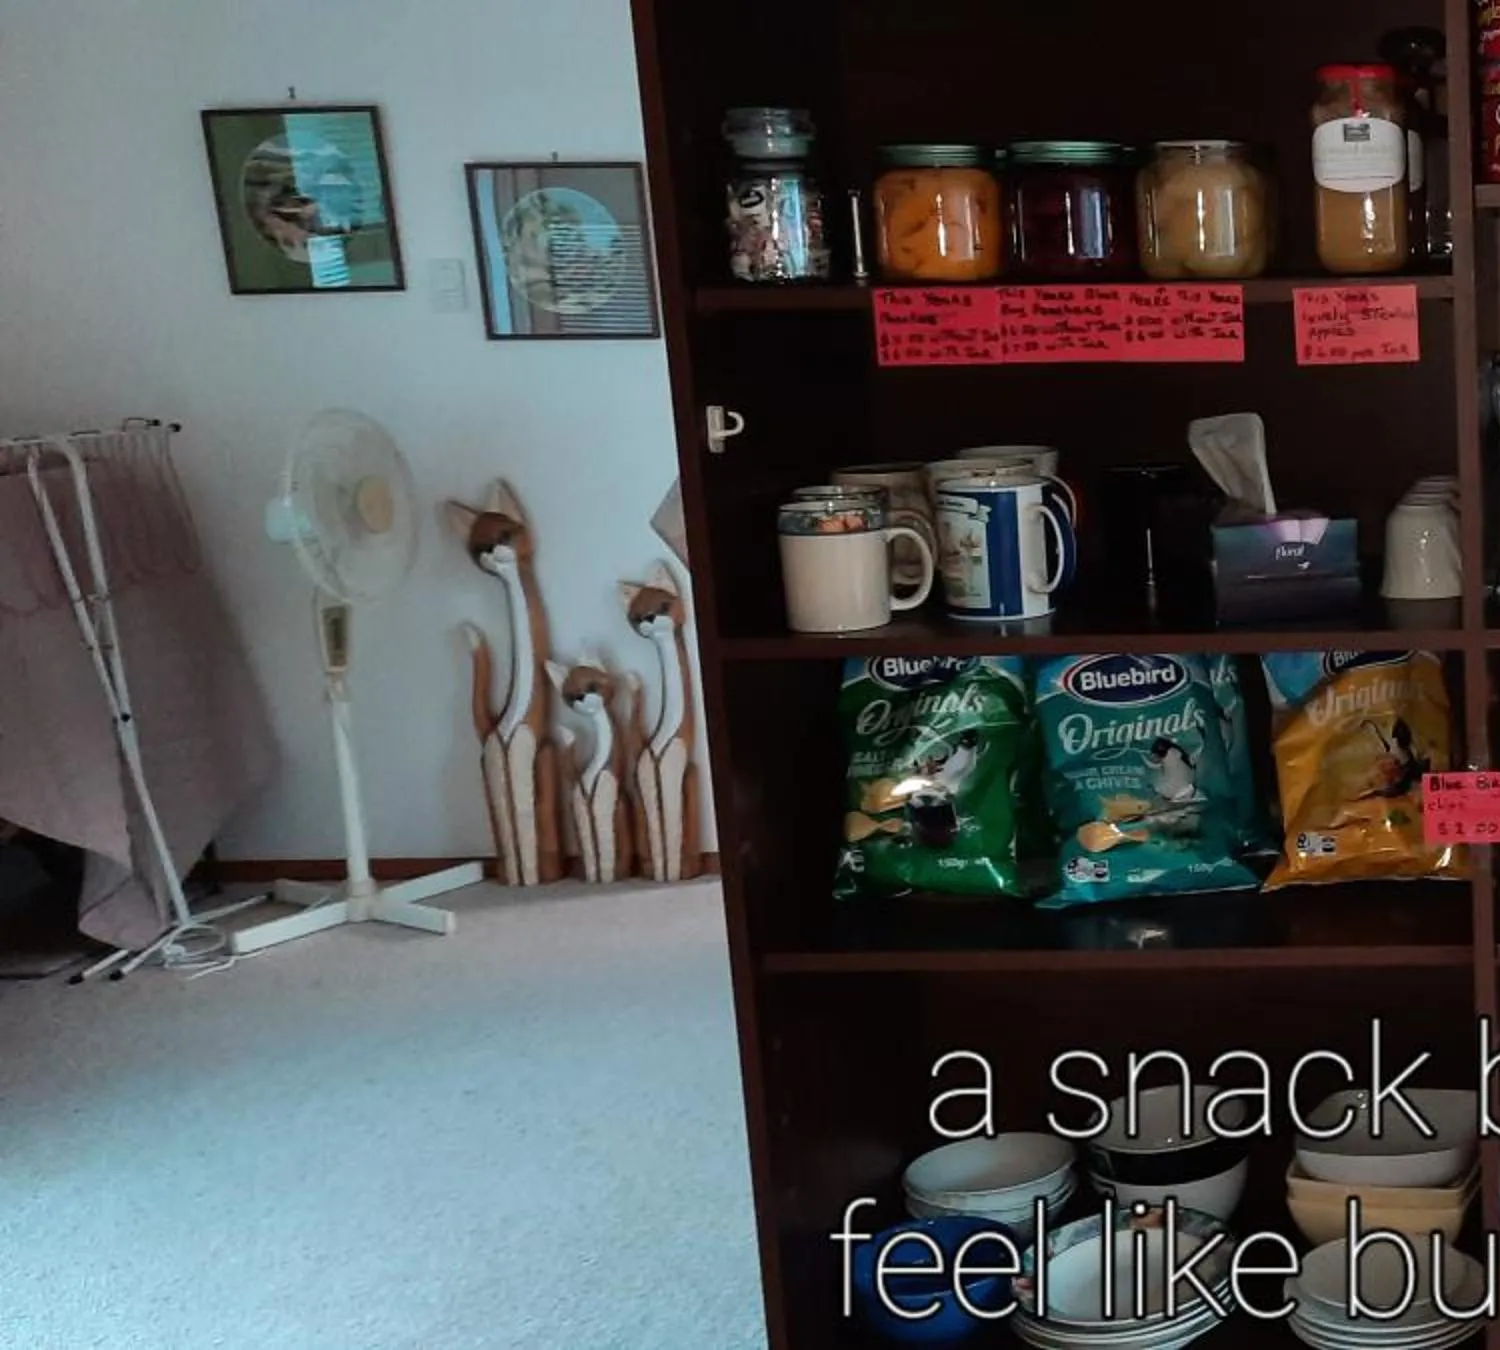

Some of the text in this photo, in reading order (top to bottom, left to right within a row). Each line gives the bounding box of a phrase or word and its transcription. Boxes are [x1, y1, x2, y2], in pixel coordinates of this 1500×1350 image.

[1078, 663, 1177, 692] Bluebird
[1057, 698, 1207, 762] Originals
[1429, 774, 1465, 793] Blue
